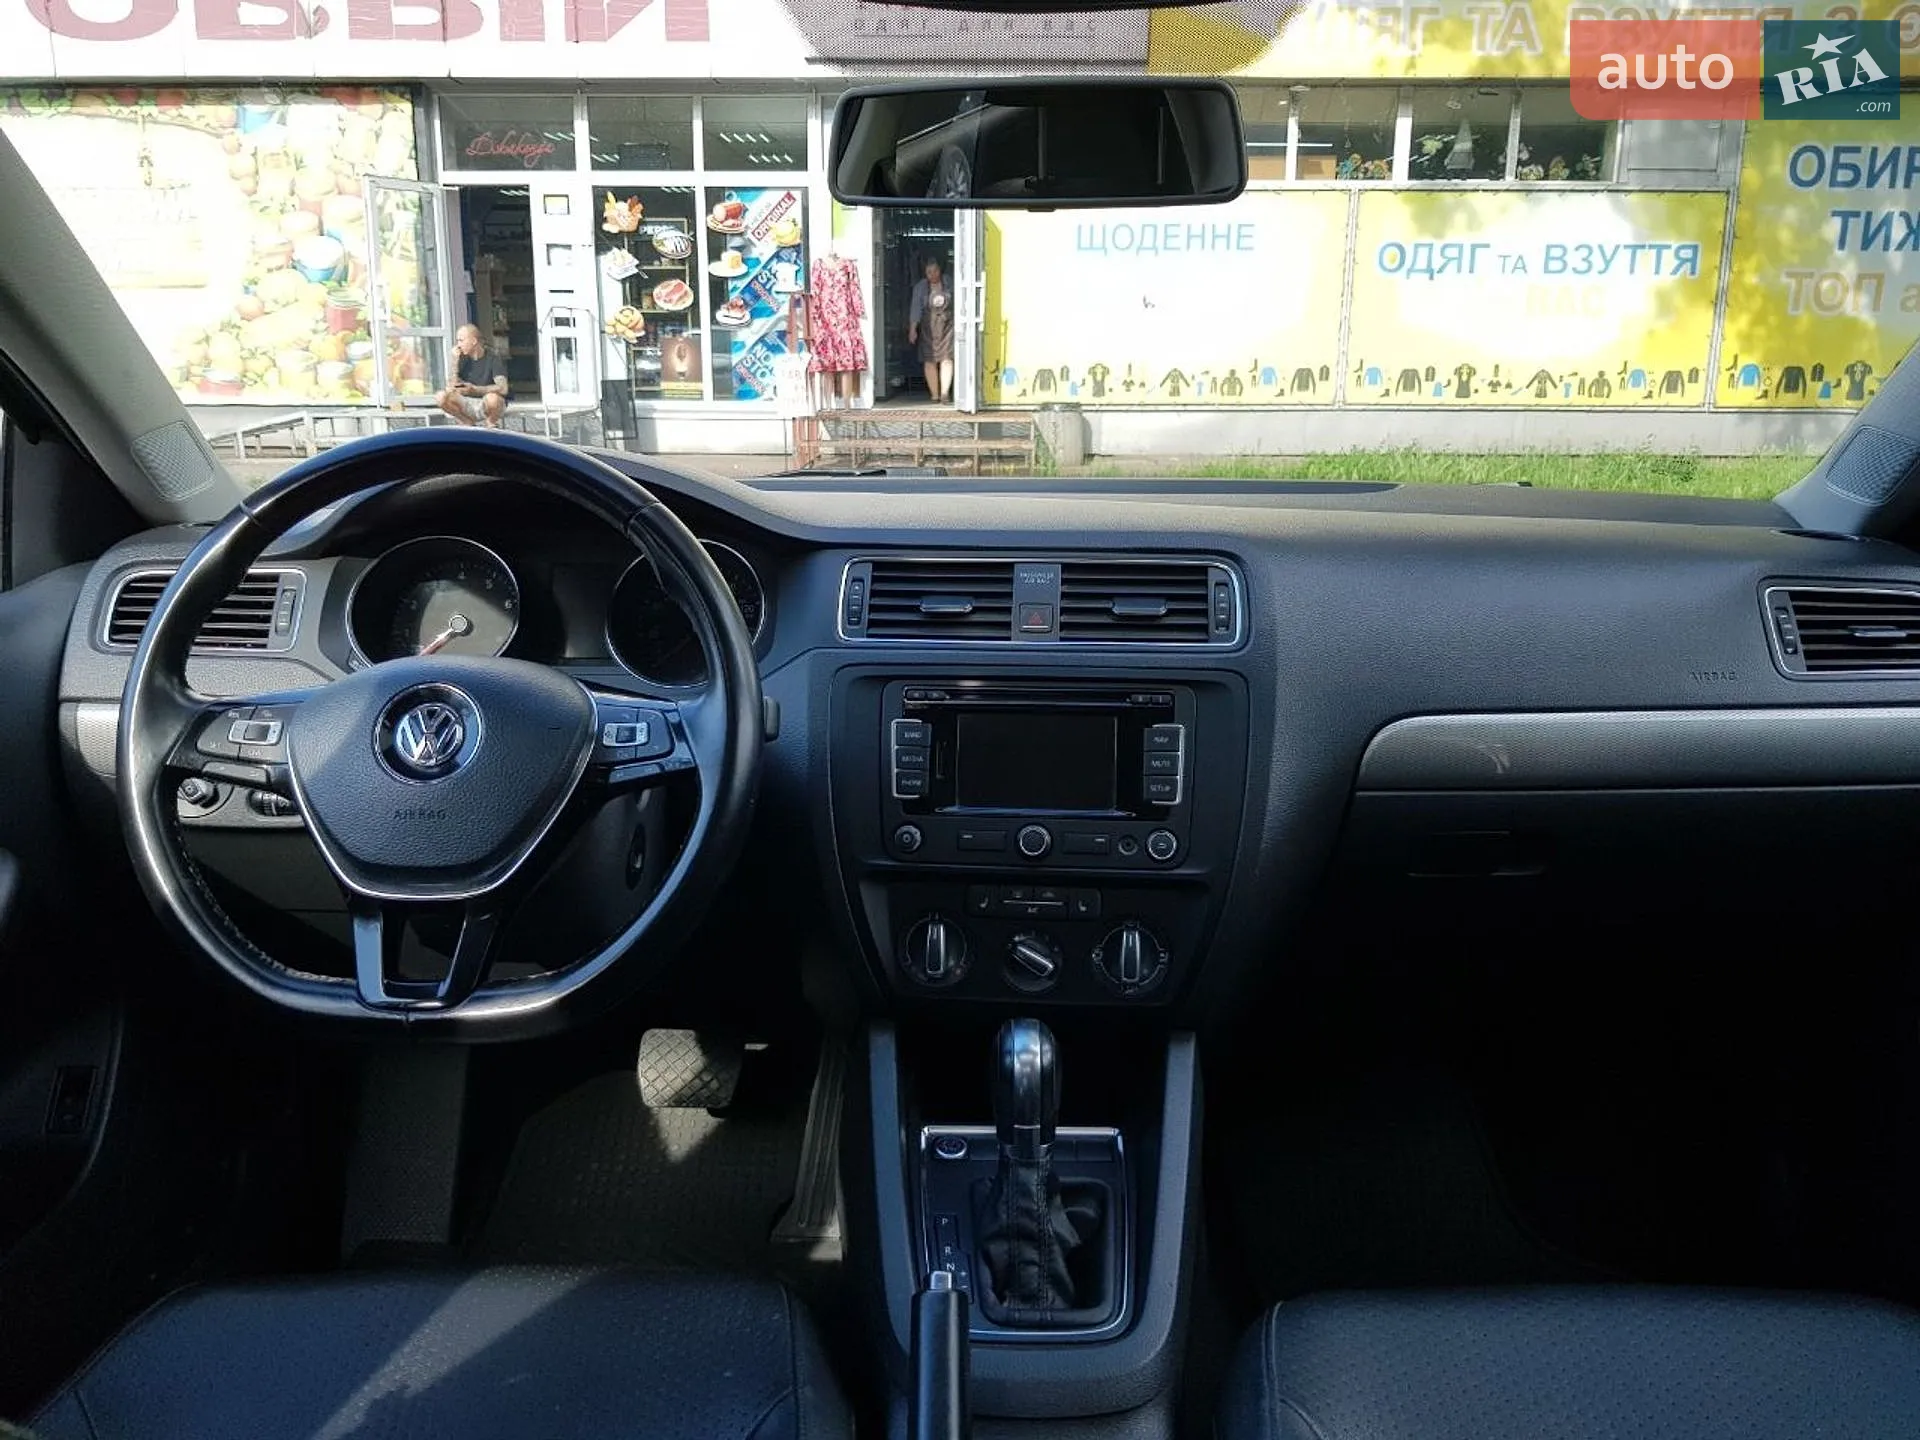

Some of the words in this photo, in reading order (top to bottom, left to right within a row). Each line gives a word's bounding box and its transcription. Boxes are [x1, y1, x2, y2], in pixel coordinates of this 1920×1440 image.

[1468, 6, 1539, 53] ТА
[1077, 223, 1256, 256] ЩОДЕННЕ
[1378, 242, 1490, 280] ОДЯГ
[1498, 254, 1528, 275] ТА
[1544, 244, 1700, 277] ВЗУТТЯ
[1785, 271, 1886, 313] ТОП
